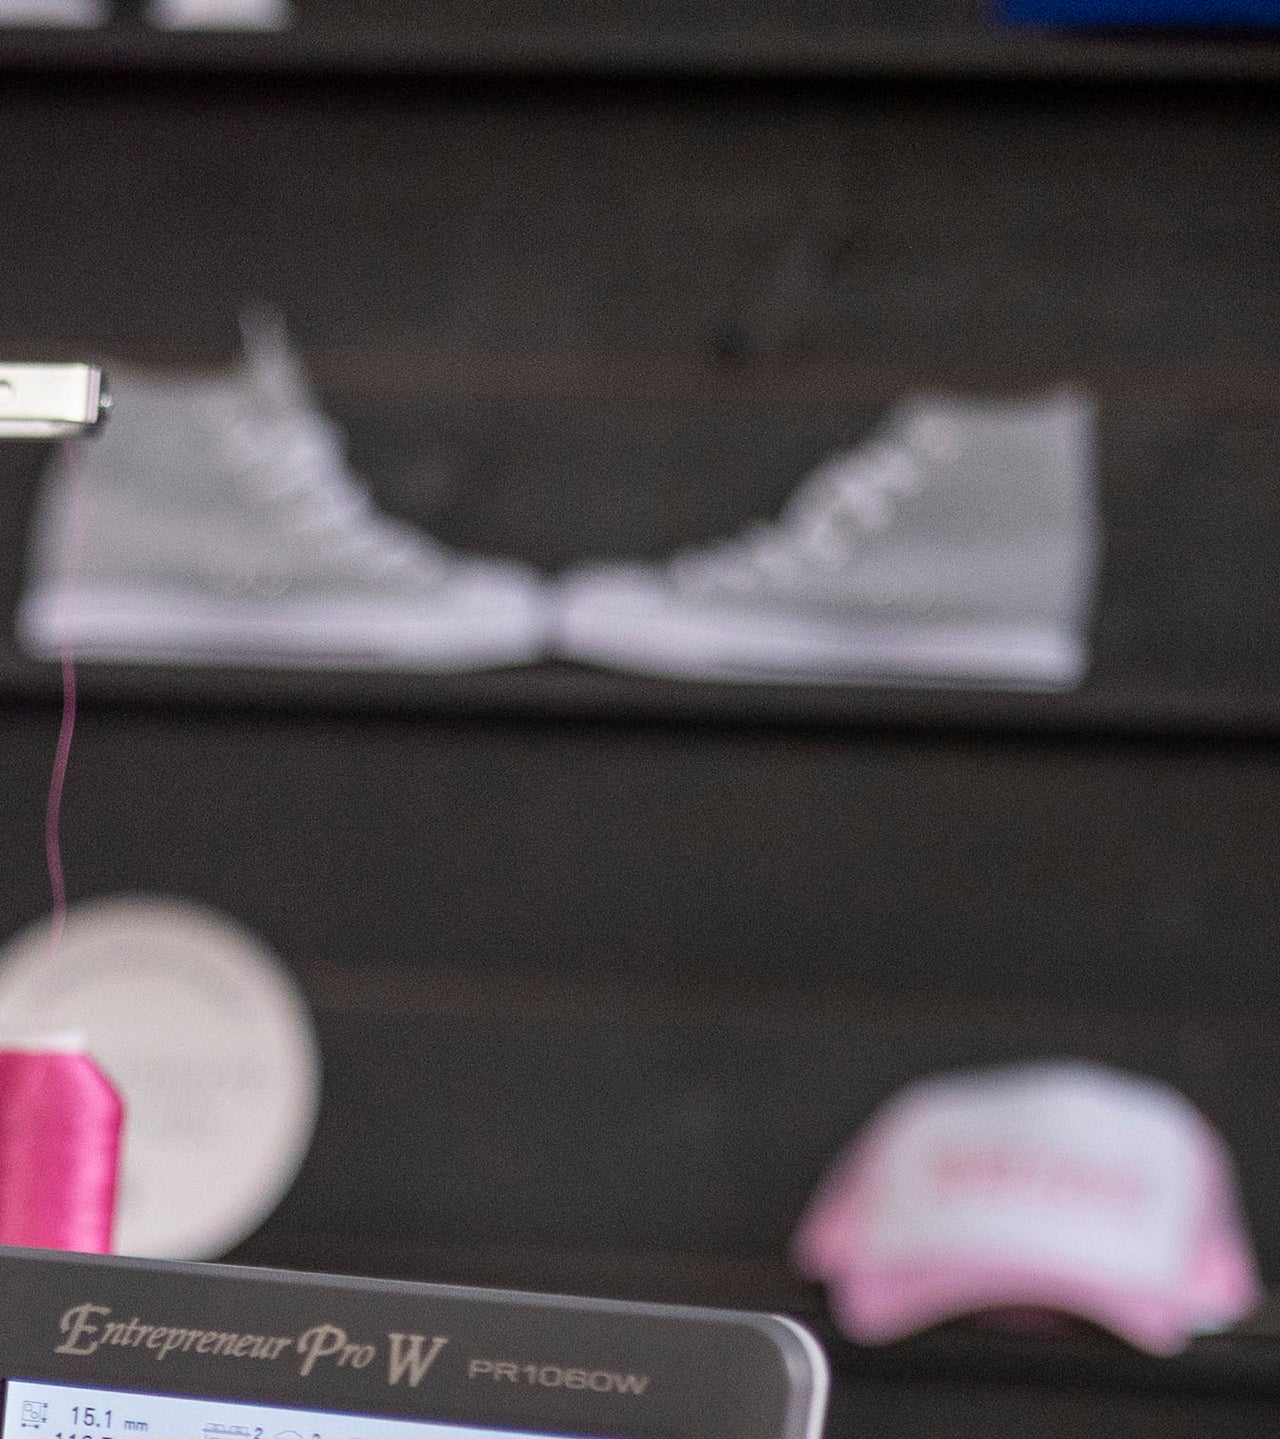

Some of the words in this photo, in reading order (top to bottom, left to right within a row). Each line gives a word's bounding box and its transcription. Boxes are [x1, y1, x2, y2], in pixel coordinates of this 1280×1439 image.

[54, 1302, 293, 1360] Entrepreneur
[297, 1324, 378, 1376] Pro
[385, 1332, 449, 1388] W
[71, 1405, 113, 1429] 15.1
[124, 1419, 149, 1431] mm
